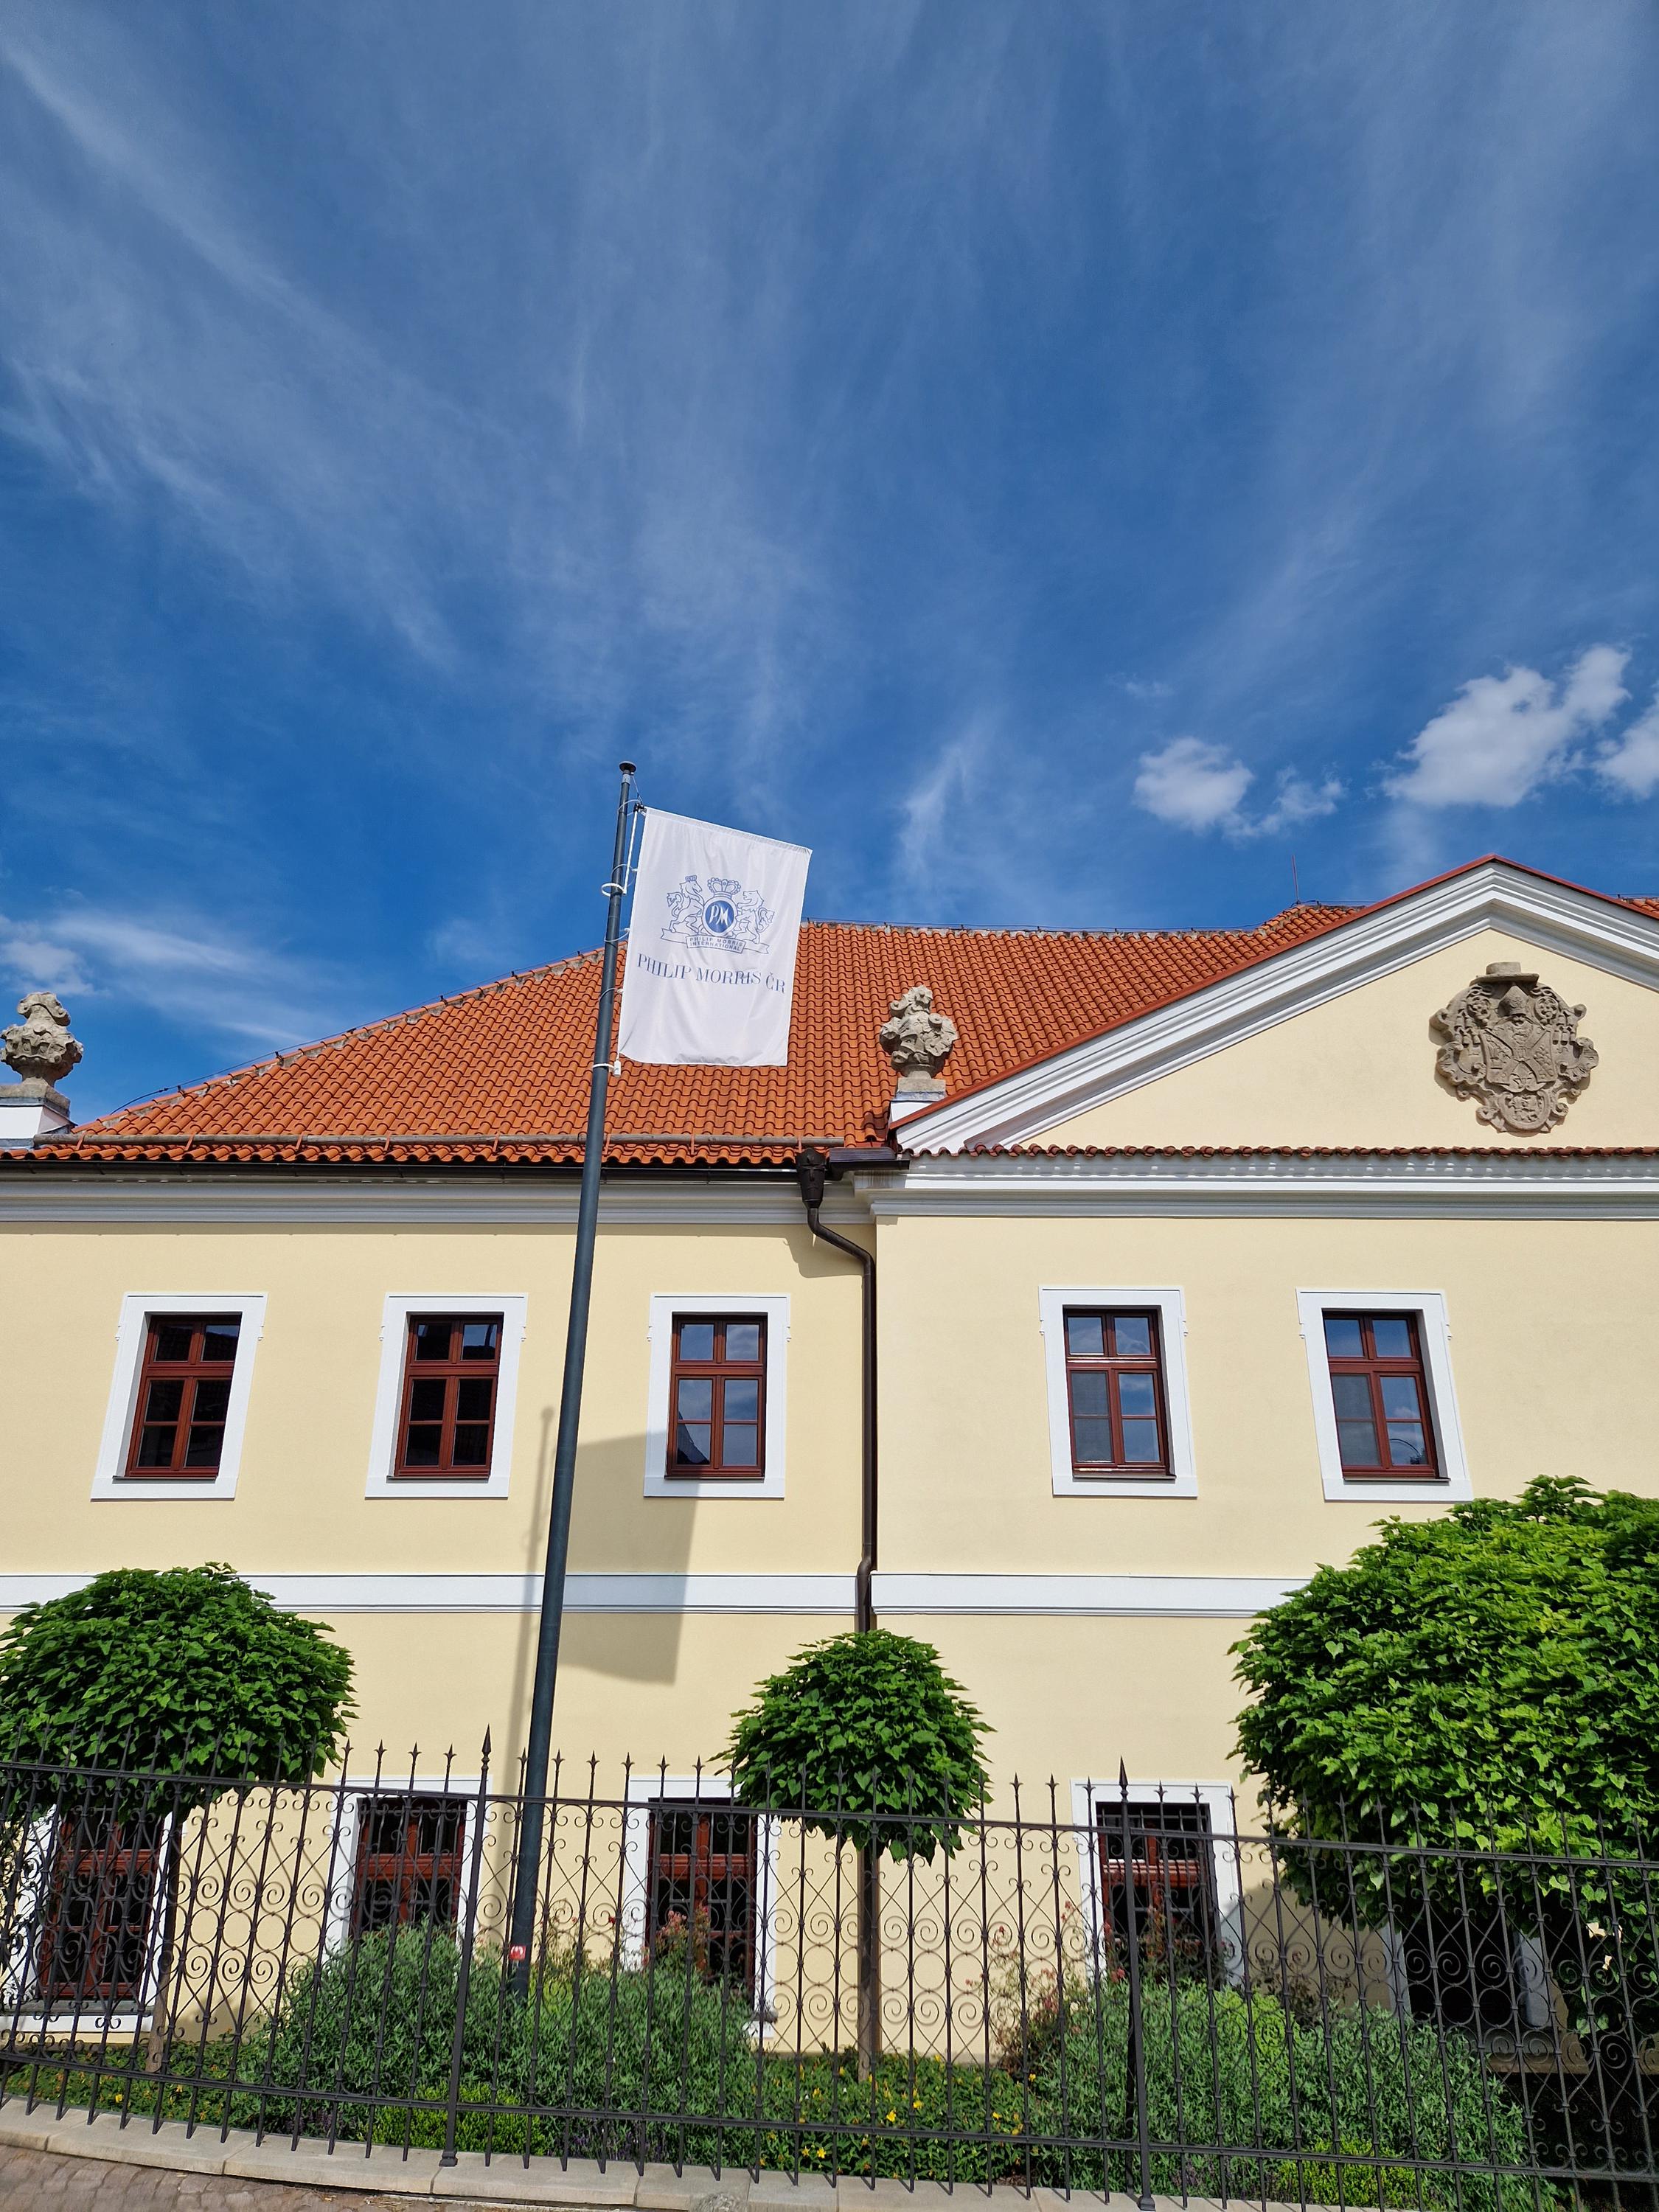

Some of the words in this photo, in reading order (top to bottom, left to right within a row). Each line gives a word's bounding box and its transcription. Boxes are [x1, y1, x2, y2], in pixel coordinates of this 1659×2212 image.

[689, 942, 740, 951] INTERNATIONAL
[717, 938, 743, 947] MORRIS
[637, 953, 692, 980] PHILIP
[695, 967, 762, 985] MORRIS
[765, 972, 785, 994] ČR
